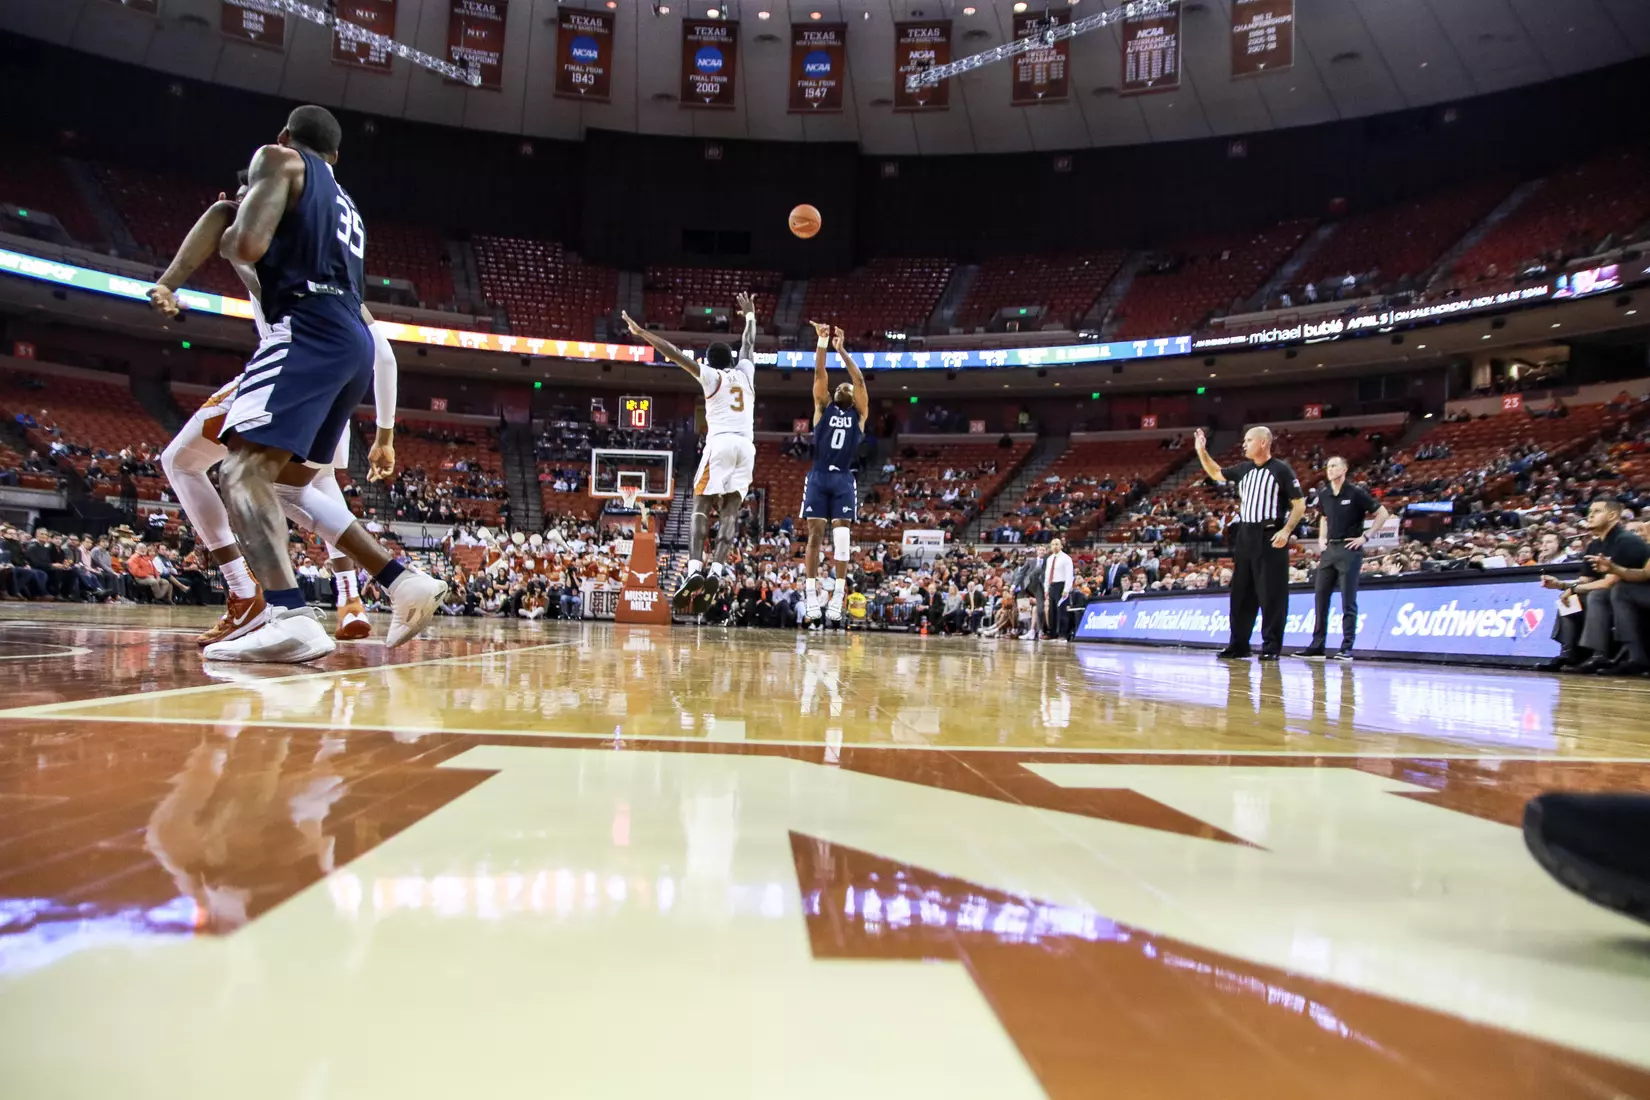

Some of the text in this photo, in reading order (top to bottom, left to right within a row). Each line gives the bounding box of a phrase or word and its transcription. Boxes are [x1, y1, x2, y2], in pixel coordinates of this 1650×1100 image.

[463, 1, 496, 13] TEXAS
[355, 9, 378, 20] NIT
[570, 15, 602, 27] TEXAS
[467, 28, 488, 38] NIT
[695, 26, 727, 36] TEXAS
[804, 31, 836, 41] TEXAS
[907, 28, 940, 37] TEXAS
[1137, 27, 1164, 39] NCAA
[572, 47, 598, 59] NCAA
[909, 50, 935, 59] NCAA
[564, 63, 603, 74] FINAL FOUR
[697, 58, 723, 68] NCAA
[805, 63, 831, 72] NCAA
[572, 72, 595, 85] 1943
[696, 82, 720, 94] 2003
[805, 88, 828, 99] 1947
[336, 194, 365, 260] 35
[1250, 324, 1301, 344] michael
[1303, 318, 1343, 337] bublé
[1346, 314, 1379, 330] APRIL
[1379, 313, 1388, 327] 5
[1394, 311, 1410, 322] ON
[1409, 307, 1430, 319] SALE
[729, 386, 745, 412] 3
[1504, 398, 1519, 409] 23
[433, 400, 445, 411] 29
[1306, 407, 1319, 417] 24
[631, 409, 646, 427] 10
[829, 415, 853, 429] CBU
[1143, 417, 1155, 427] 25
[795, 422, 807, 431] 27
[831, 428, 846, 449] 0
[624, 590, 659, 602] MUSCLE
[630, 601, 652, 611] MILK
[1084, 611, 1121, 631] Southwest
[1134, 610, 1149, 629] The
[1148, 609, 1182, 630] Official
[1179, 609, 1210, 631] Airline
[1391, 600, 1525, 639] Southwest
